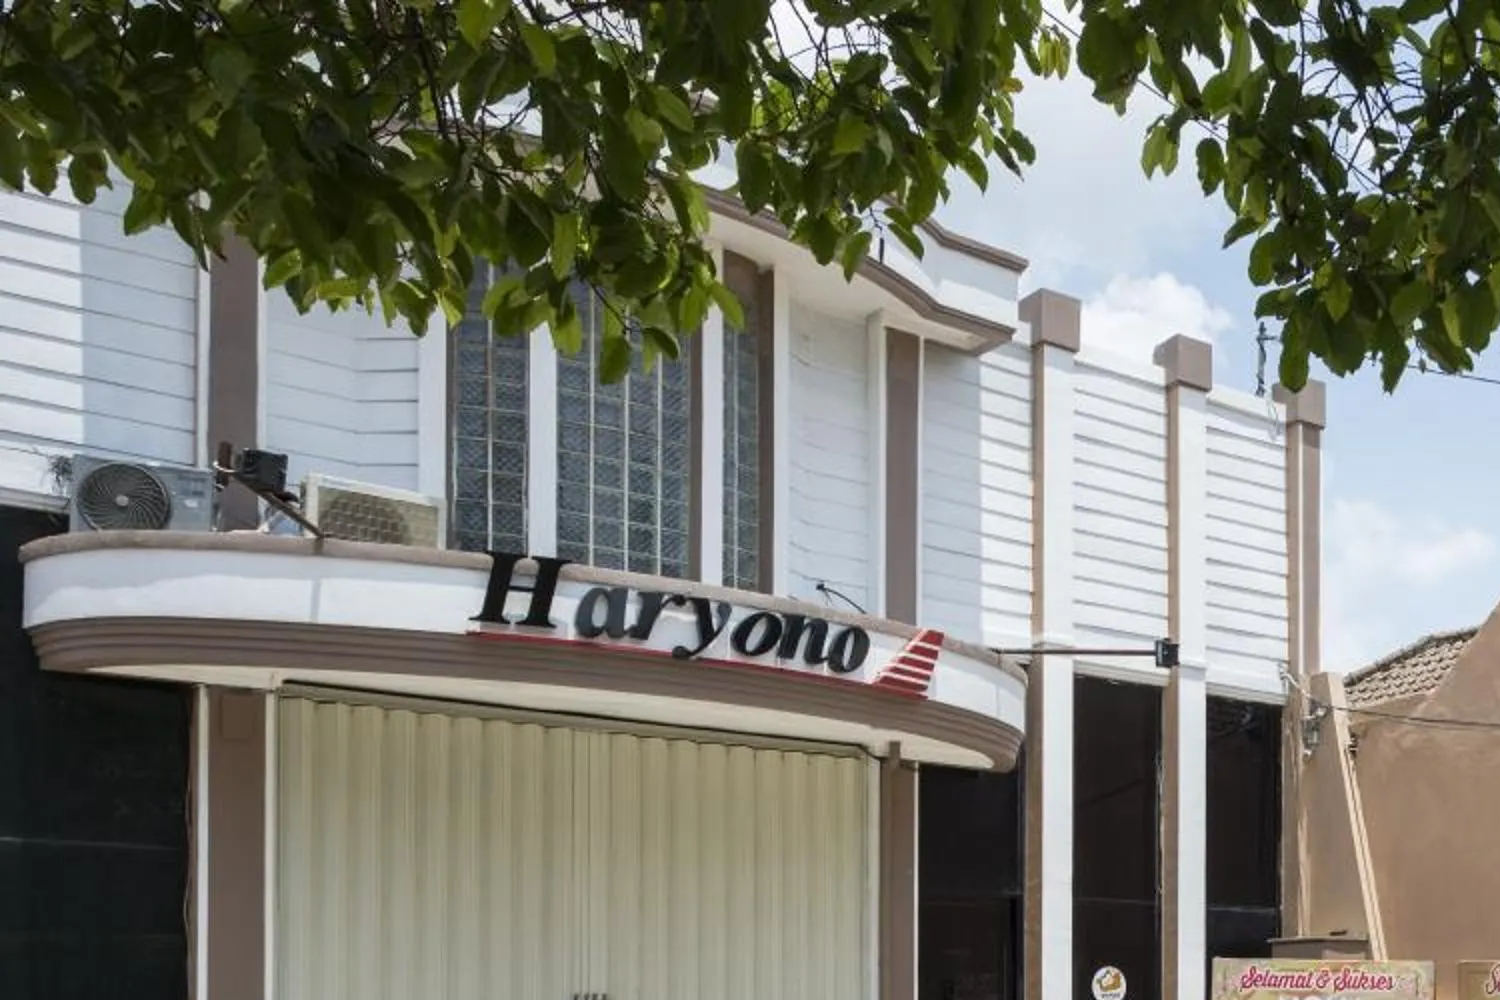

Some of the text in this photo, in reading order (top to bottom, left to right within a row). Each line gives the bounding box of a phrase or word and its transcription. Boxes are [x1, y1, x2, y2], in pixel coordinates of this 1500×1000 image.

[468, 550, 870, 673] Haryono
[1240, 966, 1313, 992] Selamat
[1334, 967, 1394, 992] Sukses
